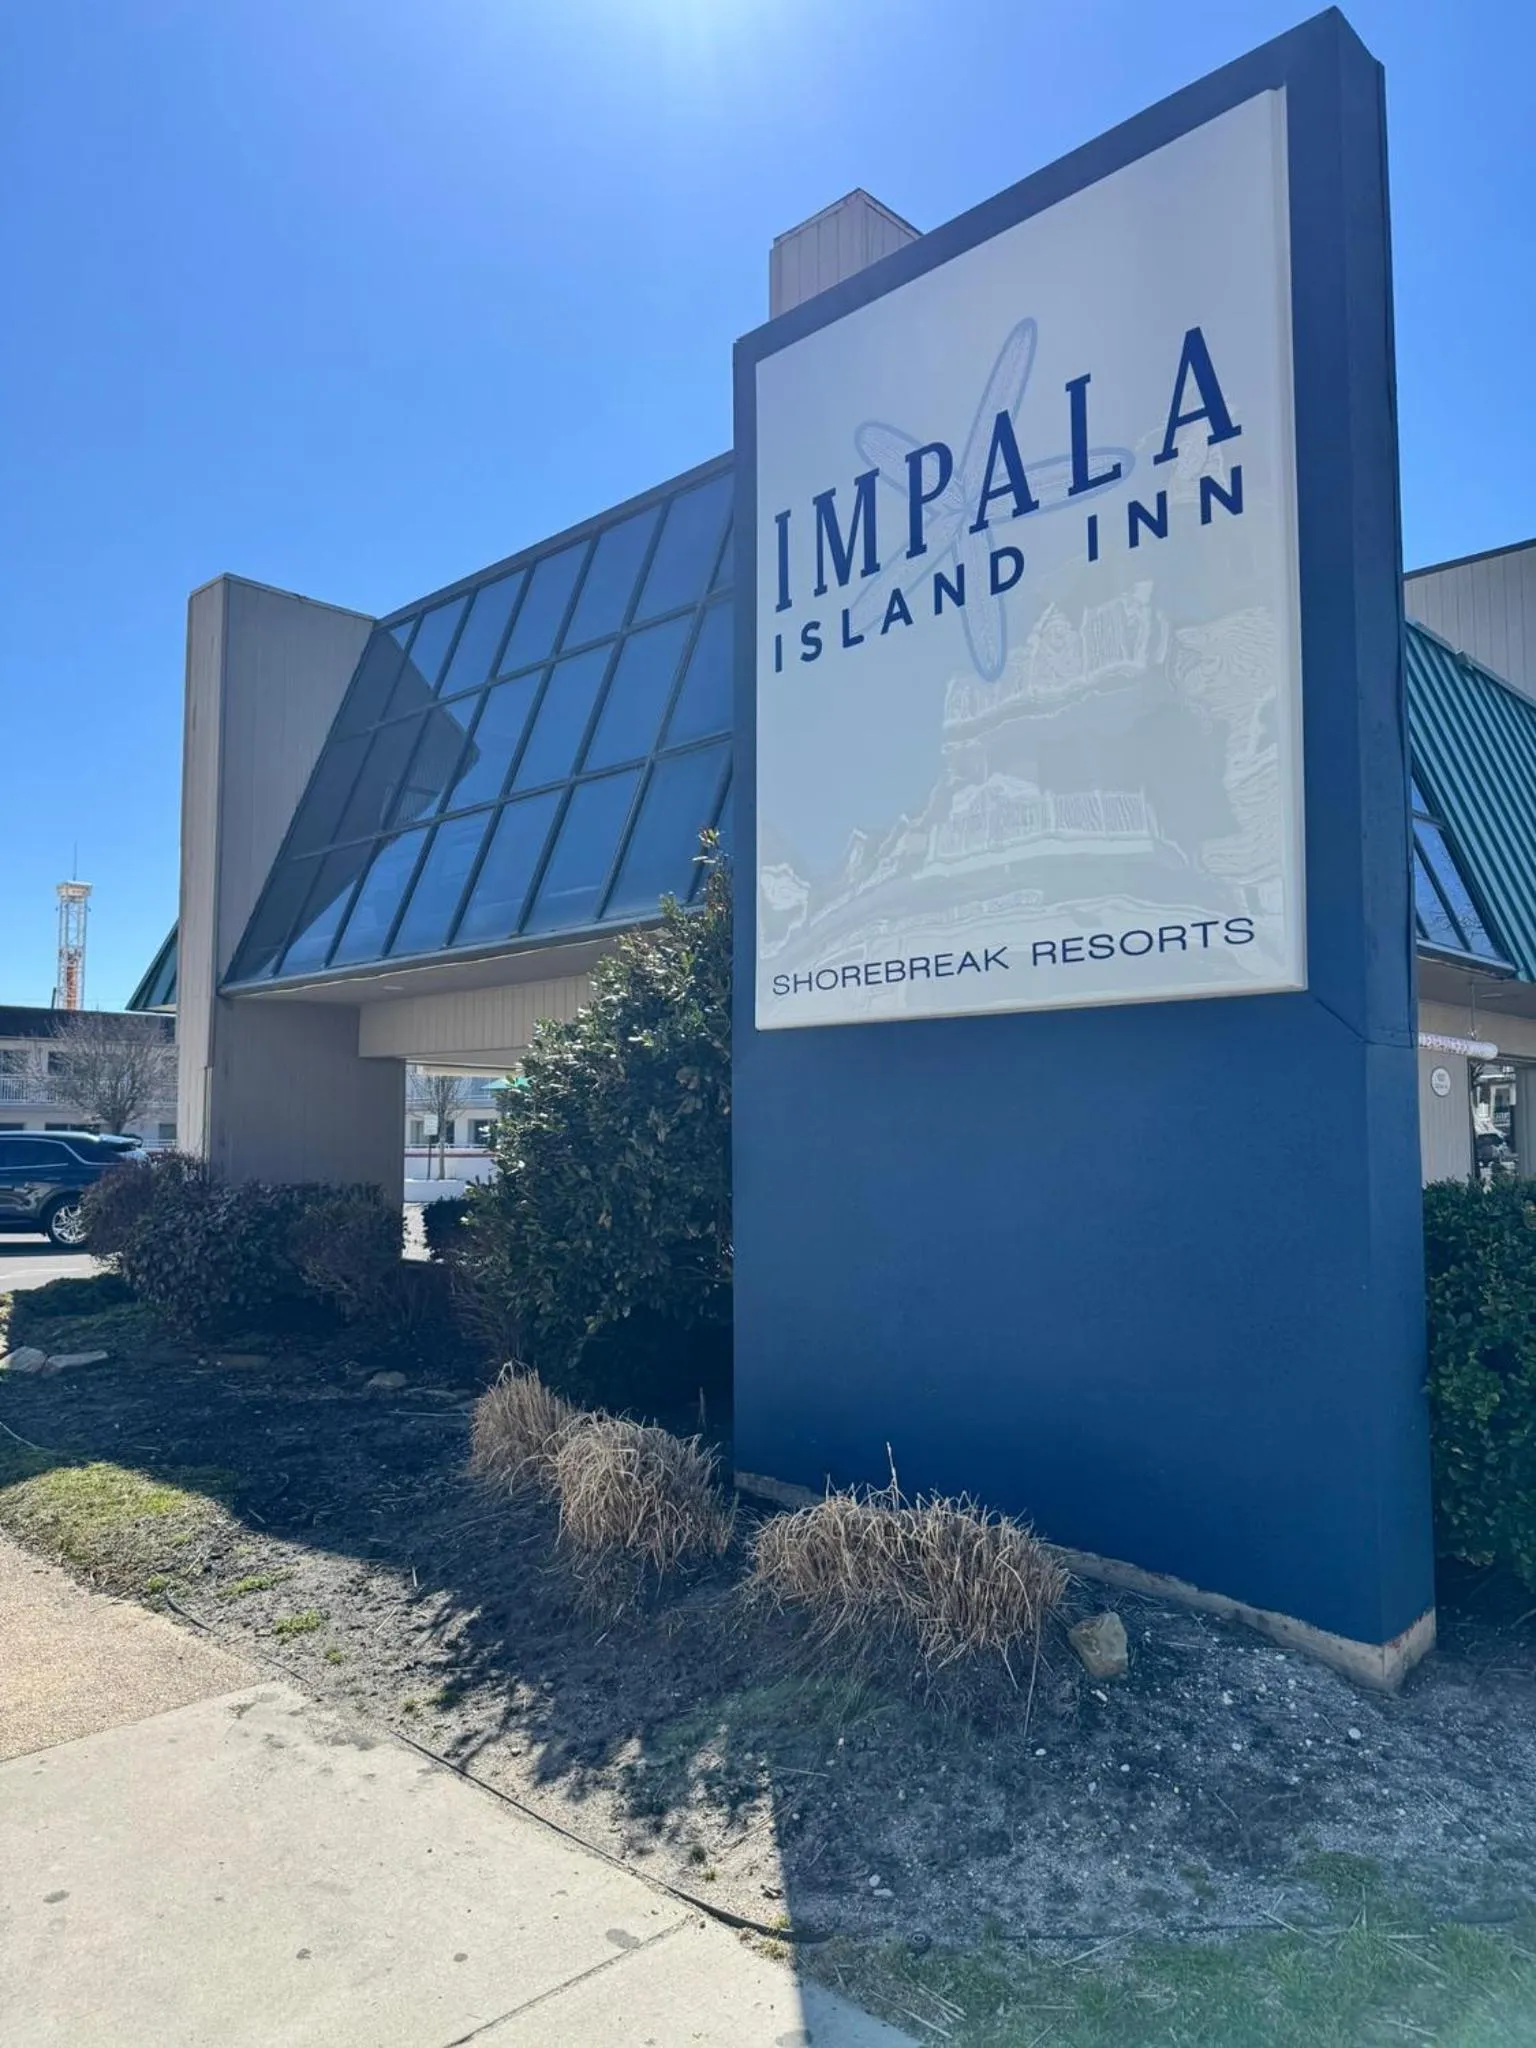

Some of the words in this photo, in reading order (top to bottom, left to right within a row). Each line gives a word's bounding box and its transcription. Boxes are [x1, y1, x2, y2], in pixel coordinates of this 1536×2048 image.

[774, 326, 1242, 612] IMPALA
[774, 546, 1025, 672] ISLAND
[1087, 465, 1244, 562] INN
[772, 946, 1009, 996] SHOREBREAK
[1031, 917, 1256, 966] RESORTS
